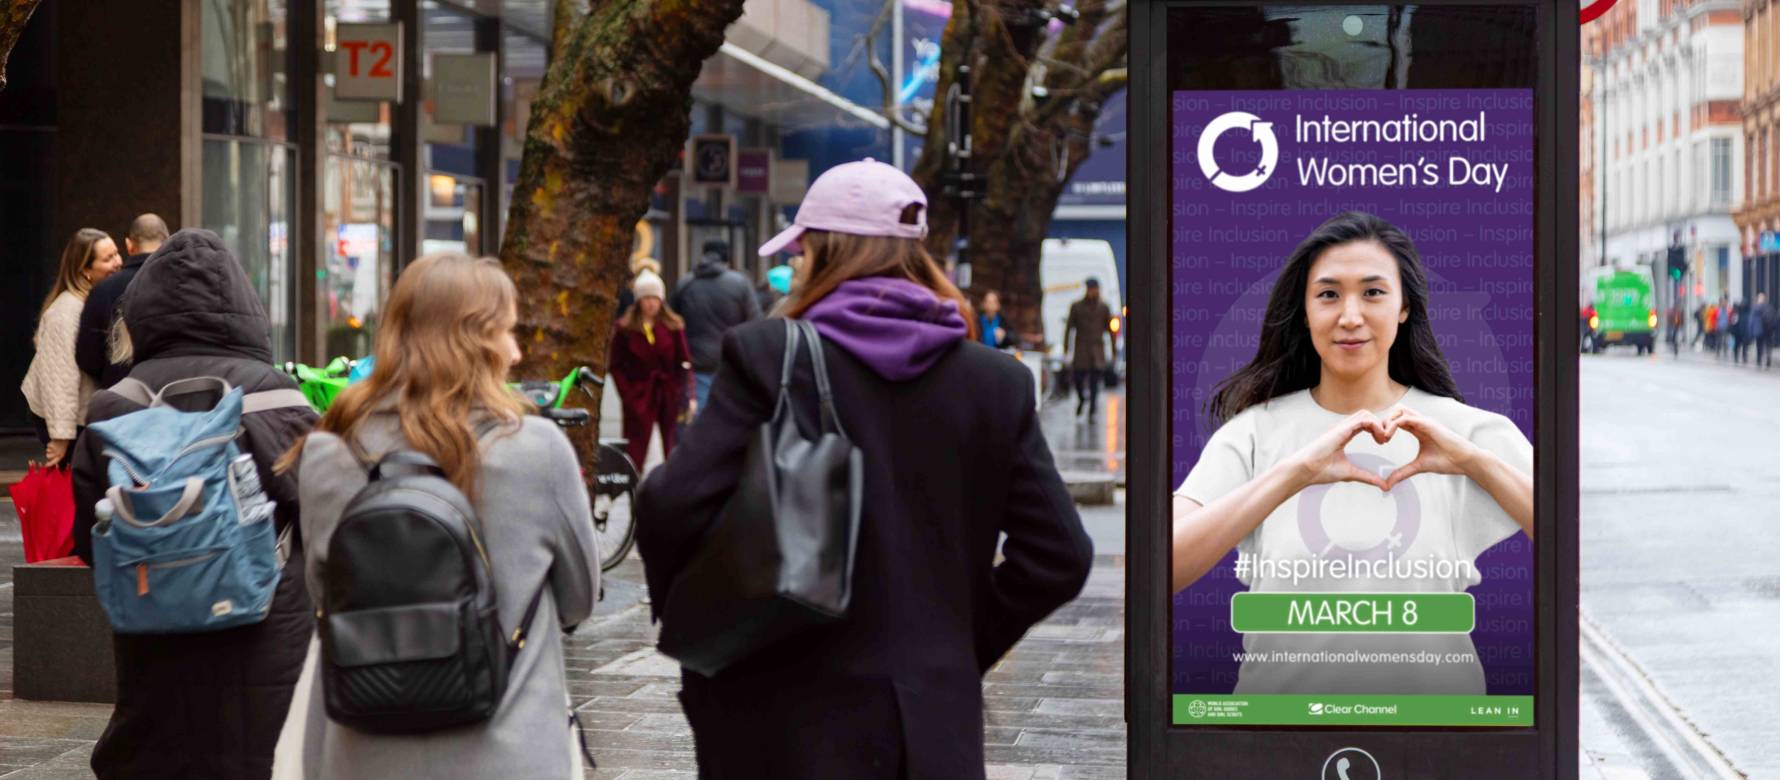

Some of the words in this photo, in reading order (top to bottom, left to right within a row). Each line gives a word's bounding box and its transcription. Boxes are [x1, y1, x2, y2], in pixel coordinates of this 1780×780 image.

[340, 39, 394, 78] T2
[1231, 95, 1292, 115] Inspire
[1298, 93, 1378, 111] Inclusion
[1400, 93, 1461, 114] Inspire
[1295, 112, 1486, 144] International
[1296, 157, 1440, 188] Women's
[1448, 156, 1509, 192] Day
[1231, 200, 1292, 221] Inspire
[1400, 200, 1461, 220] Inspire
[1208, 225, 1289, 243] Inclusion
[1233, 551, 1473, 586] #InspireInclusion
[1287, 600, 1393, 626] MARCH
[1402, 599, 1419, 626] 8
[1232, 648, 1475, 666] www.internationalwomensday.com
[1324, 703, 1352, 715] Clear
[1354, 703, 1398, 715] Channel
[1471, 706, 1502, 715] LEAN
[1507, 706, 1520, 715] IN
